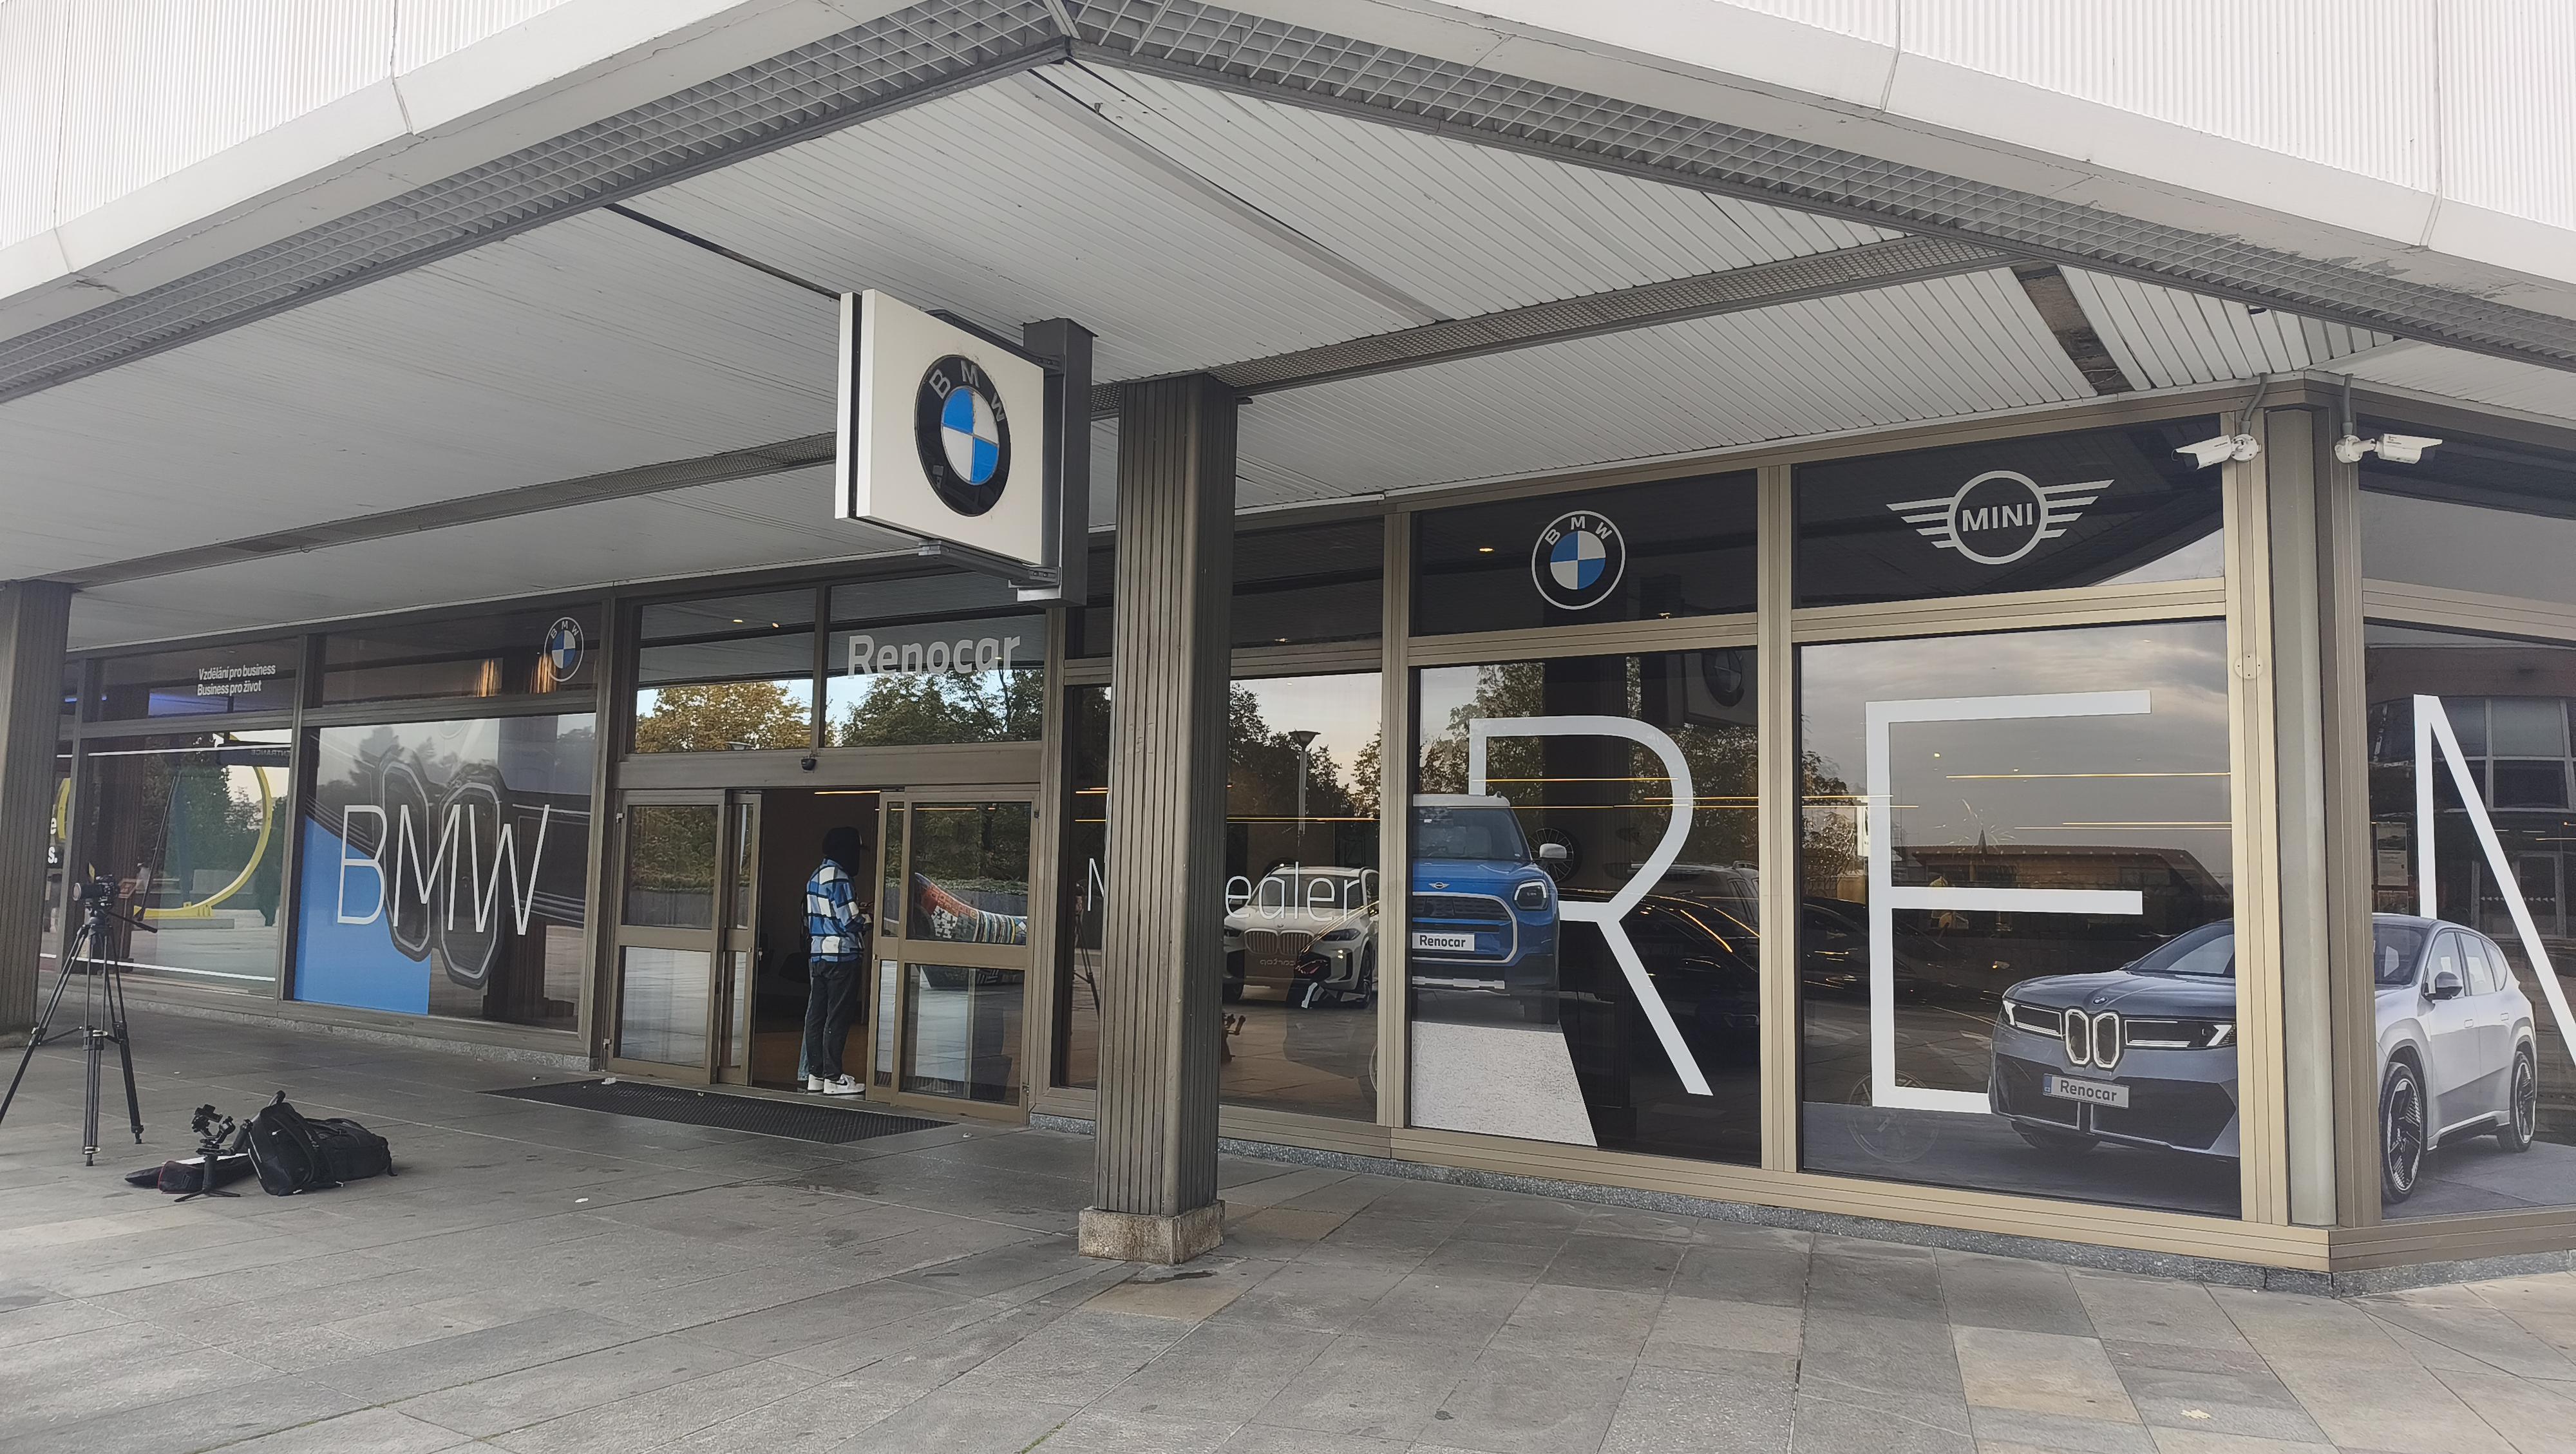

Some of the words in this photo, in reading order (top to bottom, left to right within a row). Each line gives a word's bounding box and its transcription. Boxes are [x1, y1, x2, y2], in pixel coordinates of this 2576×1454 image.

[929, 360, 1005, 422] BMW
[1544, 516, 1613, 545] BMW
[1962, 503, 2033, 532] MINI
[550, 620, 580, 639] BMW
[848, 635, 1020, 679] Renocar
[198, 666, 229, 681] Vzdělání
[229, 668, 243, 681] pro
[242, 663, 276, 677] business
[197, 683, 229, 696] Business
[229, 684, 243, 696] pro
[243, 680, 262, 692] život
[337, 804, 550, 936] BMW
[1225, 861, 1360, 921] ealer
[1419, 934, 1466, 947] Renocar
[2060, 1079, 2117, 1102] Renocar
